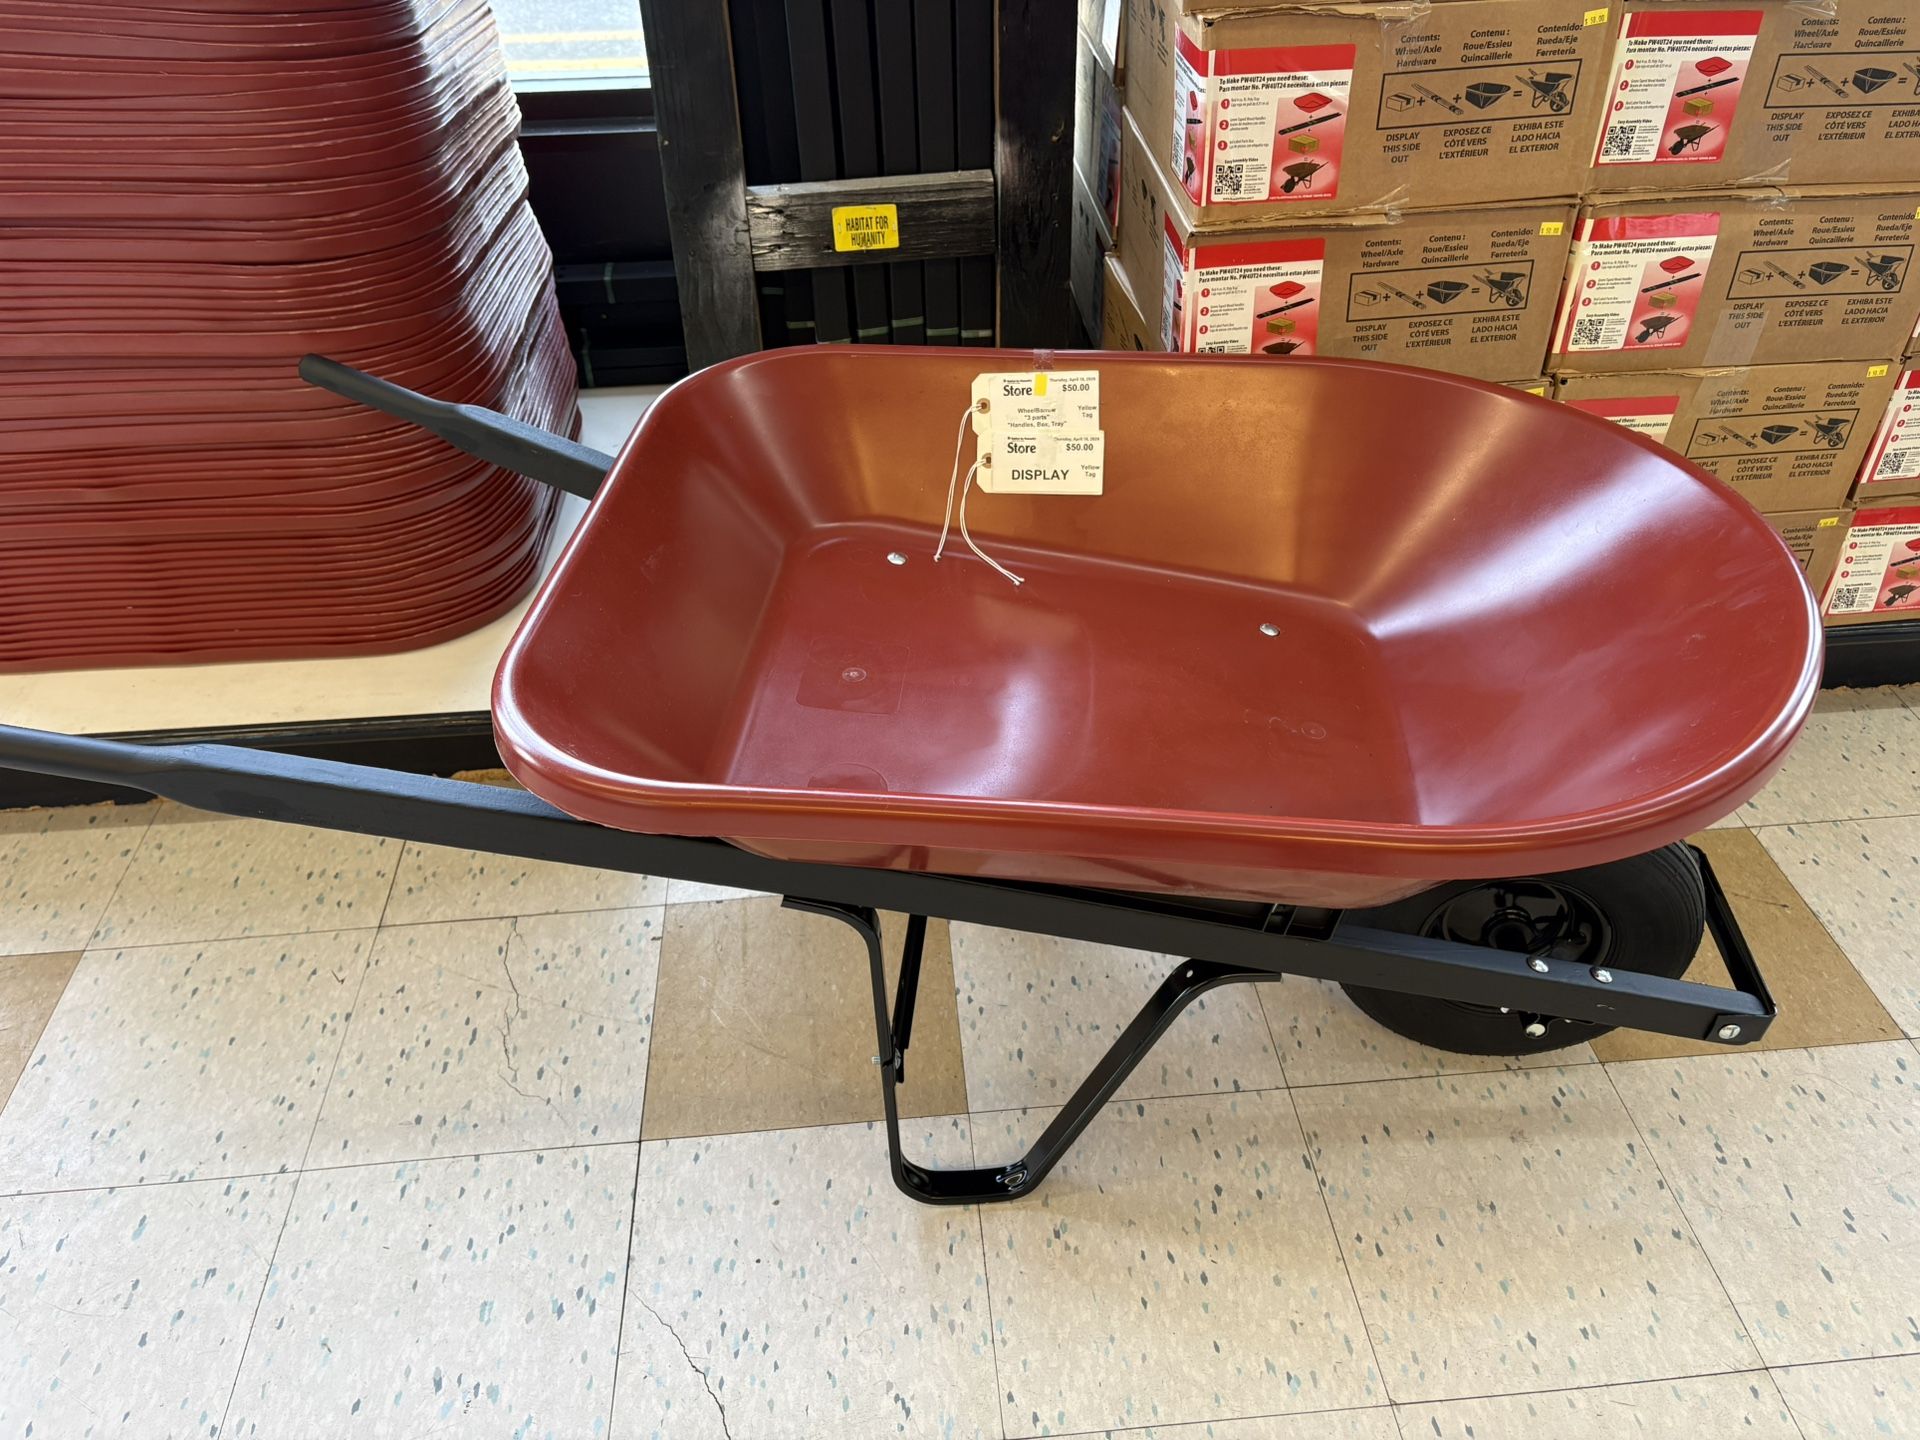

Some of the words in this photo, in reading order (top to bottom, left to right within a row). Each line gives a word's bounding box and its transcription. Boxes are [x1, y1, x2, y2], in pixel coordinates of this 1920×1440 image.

[1537, 24, 1582, 33] Contenido:
[1401, 34, 1440, 43] Contents:
[1537, 36, 1578, 46] Rueda/Eje
[1463, 40, 1512, 51] Roue/Essieu
[1855, 40, 1904, 48] Quincaillerie
[1536, 47, 1576, 57] Ferretería
[1461, 52, 1512, 63] Quincaillerie
[1397, 58, 1436, 67] Hardware
[1513, 123, 1542, 131] EXHIBA
[1543, 121, 1564, 129] ESTE
[1825, 121, 1846, 129] CÔTÉ
[1888, 120, 1910, 128] LADO
[1386, 132, 1420, 141] DISPLAY
[1443, 128, 1479, 137] EXPOSEZ
[1511, 134, 1534, 142] LADO
[1535, 132, 1560, 140] HACIA
[1444, 138, 1466, 147] CÔTÉ
[1467, 138, 1487, 146] VERS
[1383, 145, 1400, 153] THIS
[1402, 143, 1420, 151] SIDE
[1520, 143, 1559, 152] EXTERIOR
[1391, 155, 1409, 163] OUT
[845, 217, 873, 231] HABITAT
[876, 216, 888, 229] FOR
[1876, 224, 1912, 232] Rueda/Eje
[1491, 228, 1533, 237] Contenido:
[1753, 228, 1794, 236] Wheel/Axle
[1812, 226, 1855, 234] Roue/Essieu
[851, 231, 885, 246] HUMANITY
[1366, 239, 1401, 247] Contents:
[1753, 239, 1788, 247] Hardware
[1809, 236, 1854, 244] Quincaillerie
[1491, 239, 1529, 248] Rueda/Eje
[1361, 248, 1403, 258] Wheel/Axle
[1423, 244, 1468, 253] Roue/Essieu
[1491, 249, 1528, 258] Ferretería
[1421, 254, 1469, 264] Quincaillerie
[1363, 260, 1399, 268] Hardware
[1243, 267, 1252, 275] you
[1473, 315, 1501, 323] EXHIBA
[1501, 314, 1520, 322] ESTE
[1851, 316, 1885, 324] EXTERIOR
[1356, 324, 1386, 332] DISPLAY
[1409, 320, 1441, 328] EXPOSEZ
[1472, 325, 1493, 333] LADO
[1494, 324, 1518, 332] HACIA
[1371, 333, 1388, 341] SIDE
[1410, 328, 1430, 338] CÔTÉ
[1481, 334, 1516, 342] EXTERIOR
[1003, 385, 1032, 396] Store
[1062, 384, 1089, 392] $50.00
[1828, 382, 1864, 390] Contenido:
[1007, 442, 1036, 454] Store
[1066, 443, 1093, 451] $50.00
[1812, 461, 1833, 469] HACIA
[1012, 470, 1069, 480] DISPLAY
